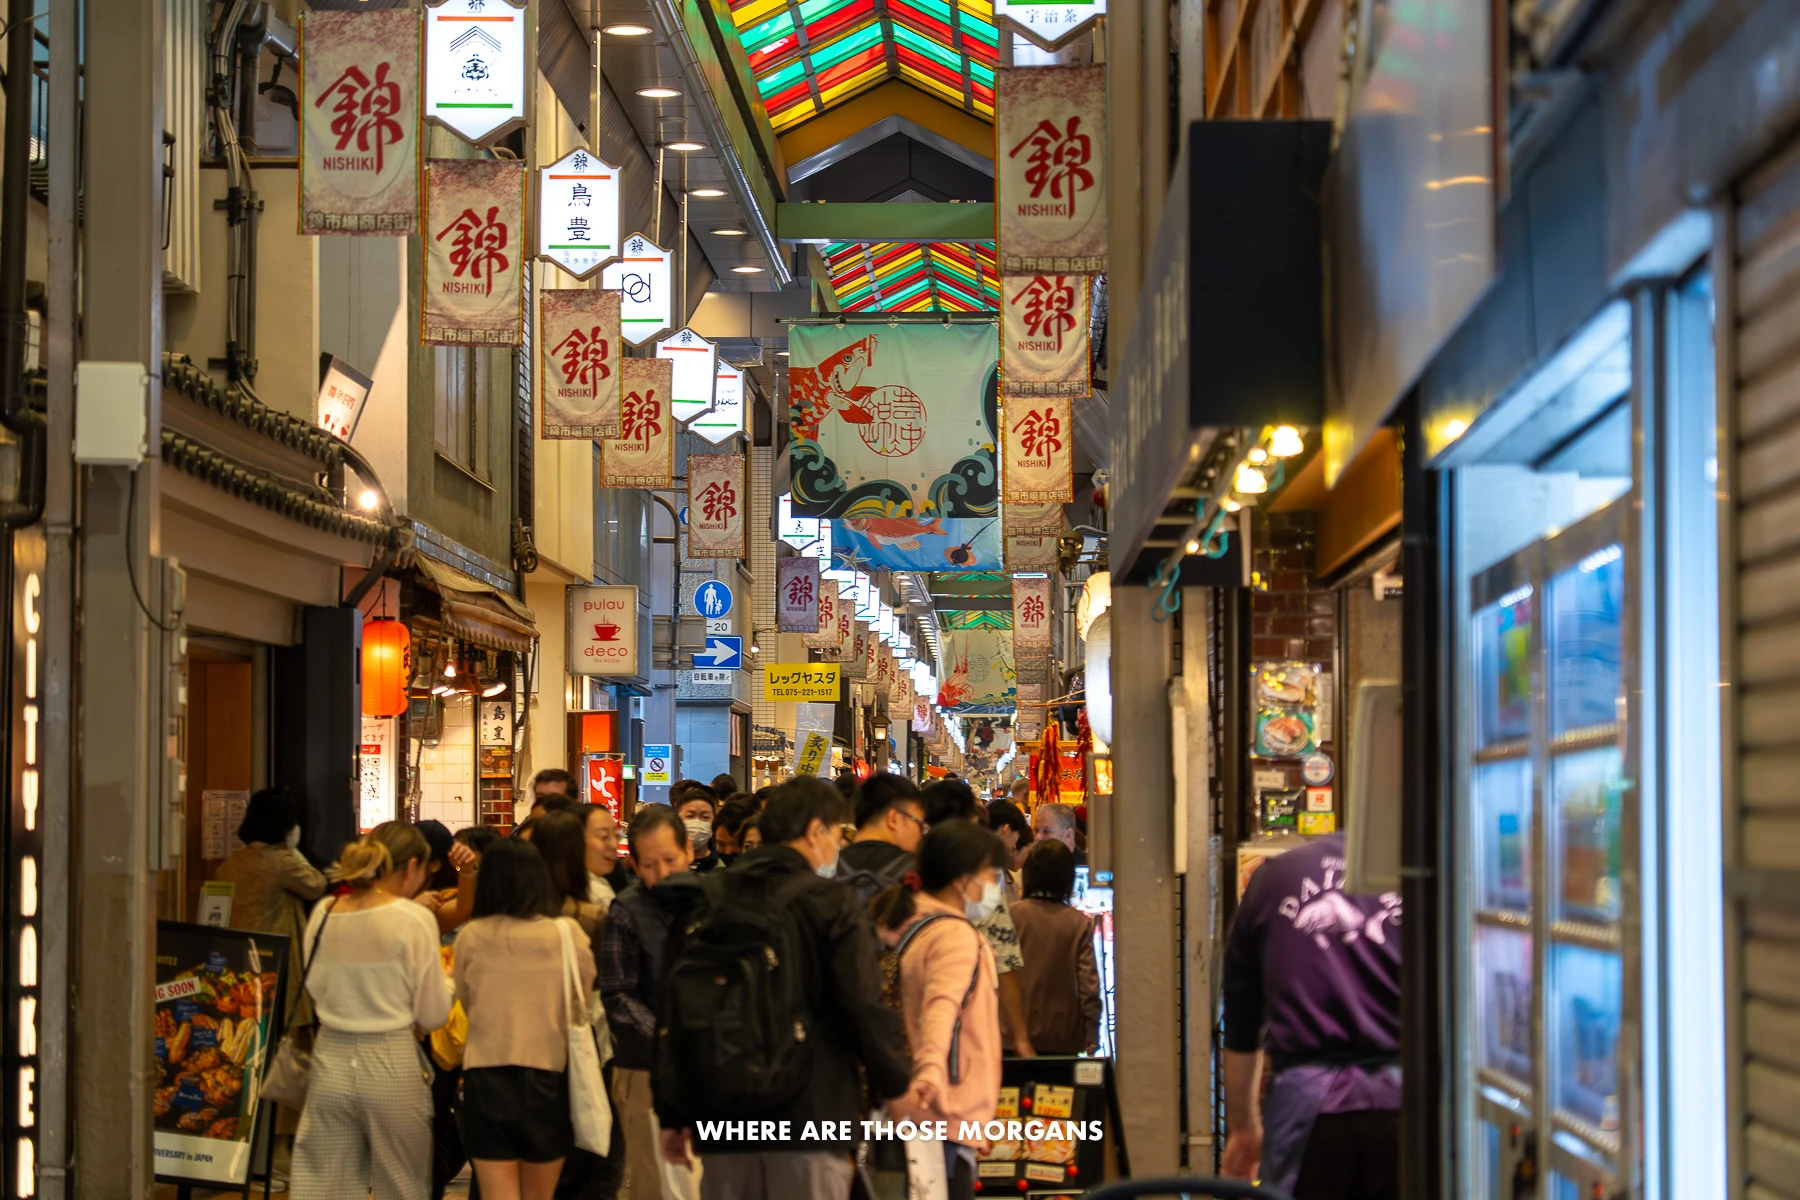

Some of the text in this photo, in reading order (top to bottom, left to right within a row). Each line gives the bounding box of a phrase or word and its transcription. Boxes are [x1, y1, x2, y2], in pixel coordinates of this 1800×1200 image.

[314, 61, 404, 176] 錦
[323, 157, 374, 171] NISHIKI
[1009, 115, 1095, 220] 錦
[1017, 203, 1068, 217] NISHIKI
[308, 212, 411, 231] 錦市場商店街
[435, 205, 510, 298] 錦
[1005, 256, 1103, 273] 錦市場商店街
[442, 281, 485, 293] NISHIKI
[1010, 275, 1077, 354] 錦
[429, 326, 514, 343] 錦市場商店街
[1018, 340, 1056, 351] NISHIKI
[550, 325, 611, 400] 錦
[557, 387, 592, 398] NISHIKI
[1007, 380, 1085, 395] 錦市場商店街
[549, 424, 618, 437] 錦市場商店街
[1011, 406, 1063, 471] 錦
[614, 442, 645, 452] NISHIKI
[1017, 458, 1047, 469] NISHIKI
[606, 475, 667, 487] 錦市場商店街
[1010, 491, 1069, 502] 錦市場商店街
[695, 479, 737, 532] 錦
[699, 522, 723, 530] NISHIKI
[783, 574, 814, 613] 錦
[583, 598, 625, 613] pulau
[1017, 594, 1046, 630] 錦
[584, 645, 628, 657] deco
[769, 671, 837, 685] レッグヤスダ
[772, 688, 833, 696] TEL 075-221-1517
[167, 979, 196, 998] SOON
